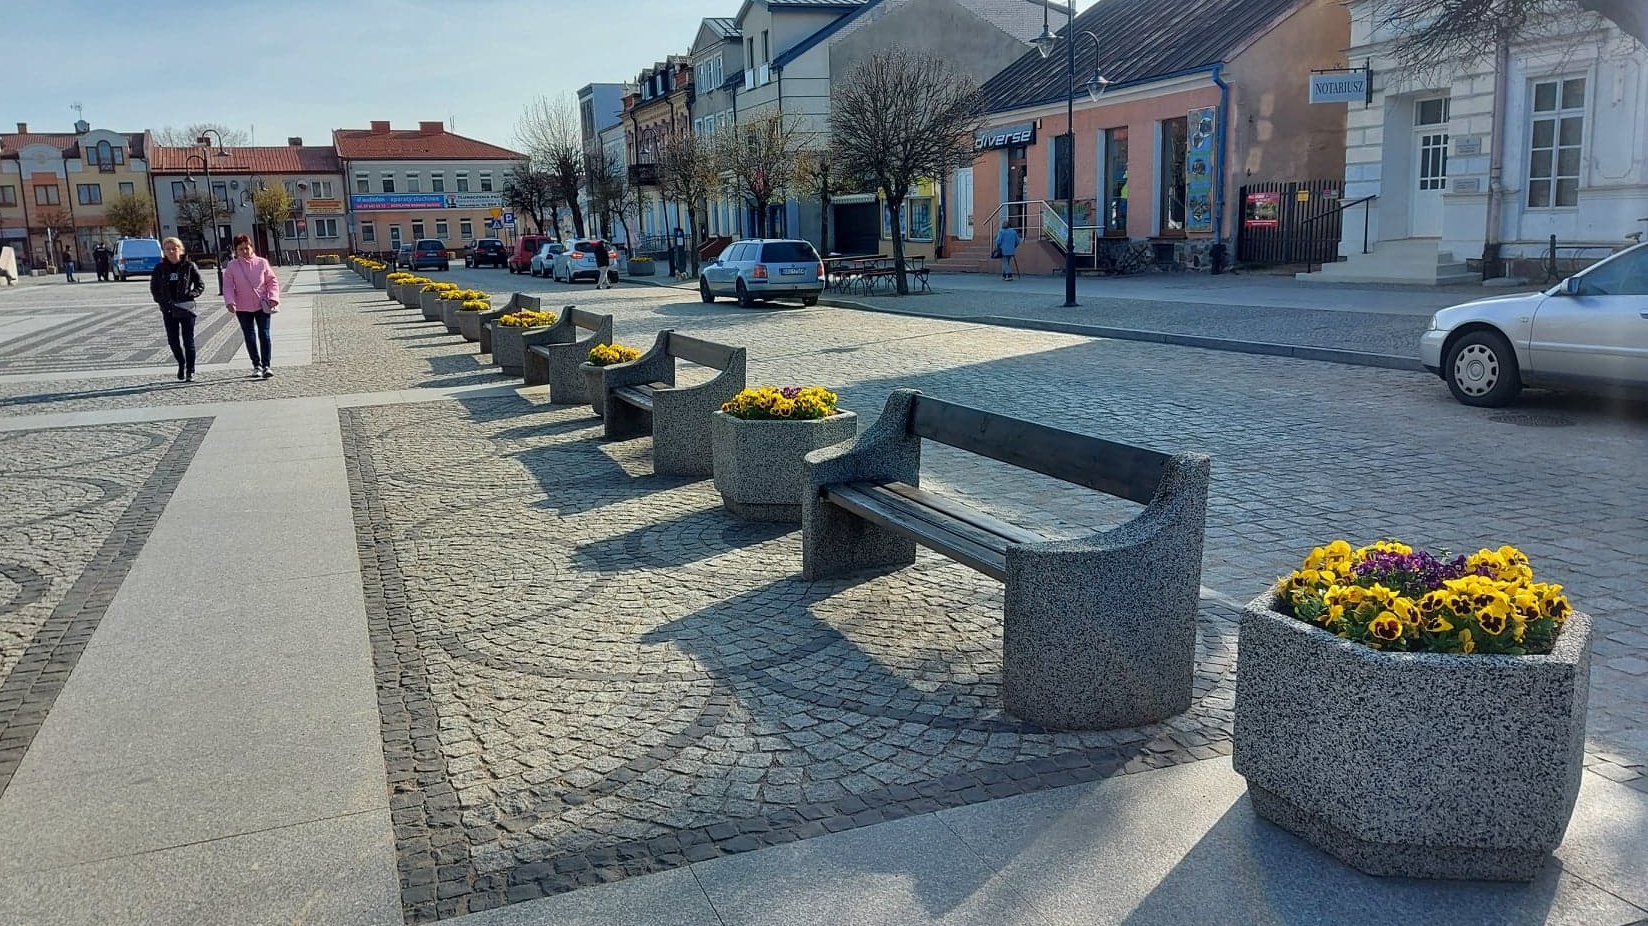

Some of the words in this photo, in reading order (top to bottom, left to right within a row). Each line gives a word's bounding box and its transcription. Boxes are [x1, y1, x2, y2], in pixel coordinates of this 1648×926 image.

[1315, 81, 1363, 95] NOTARIUSZ
[975, 130, 1032, 149] diverse
[505, 214, 512, 222] P
